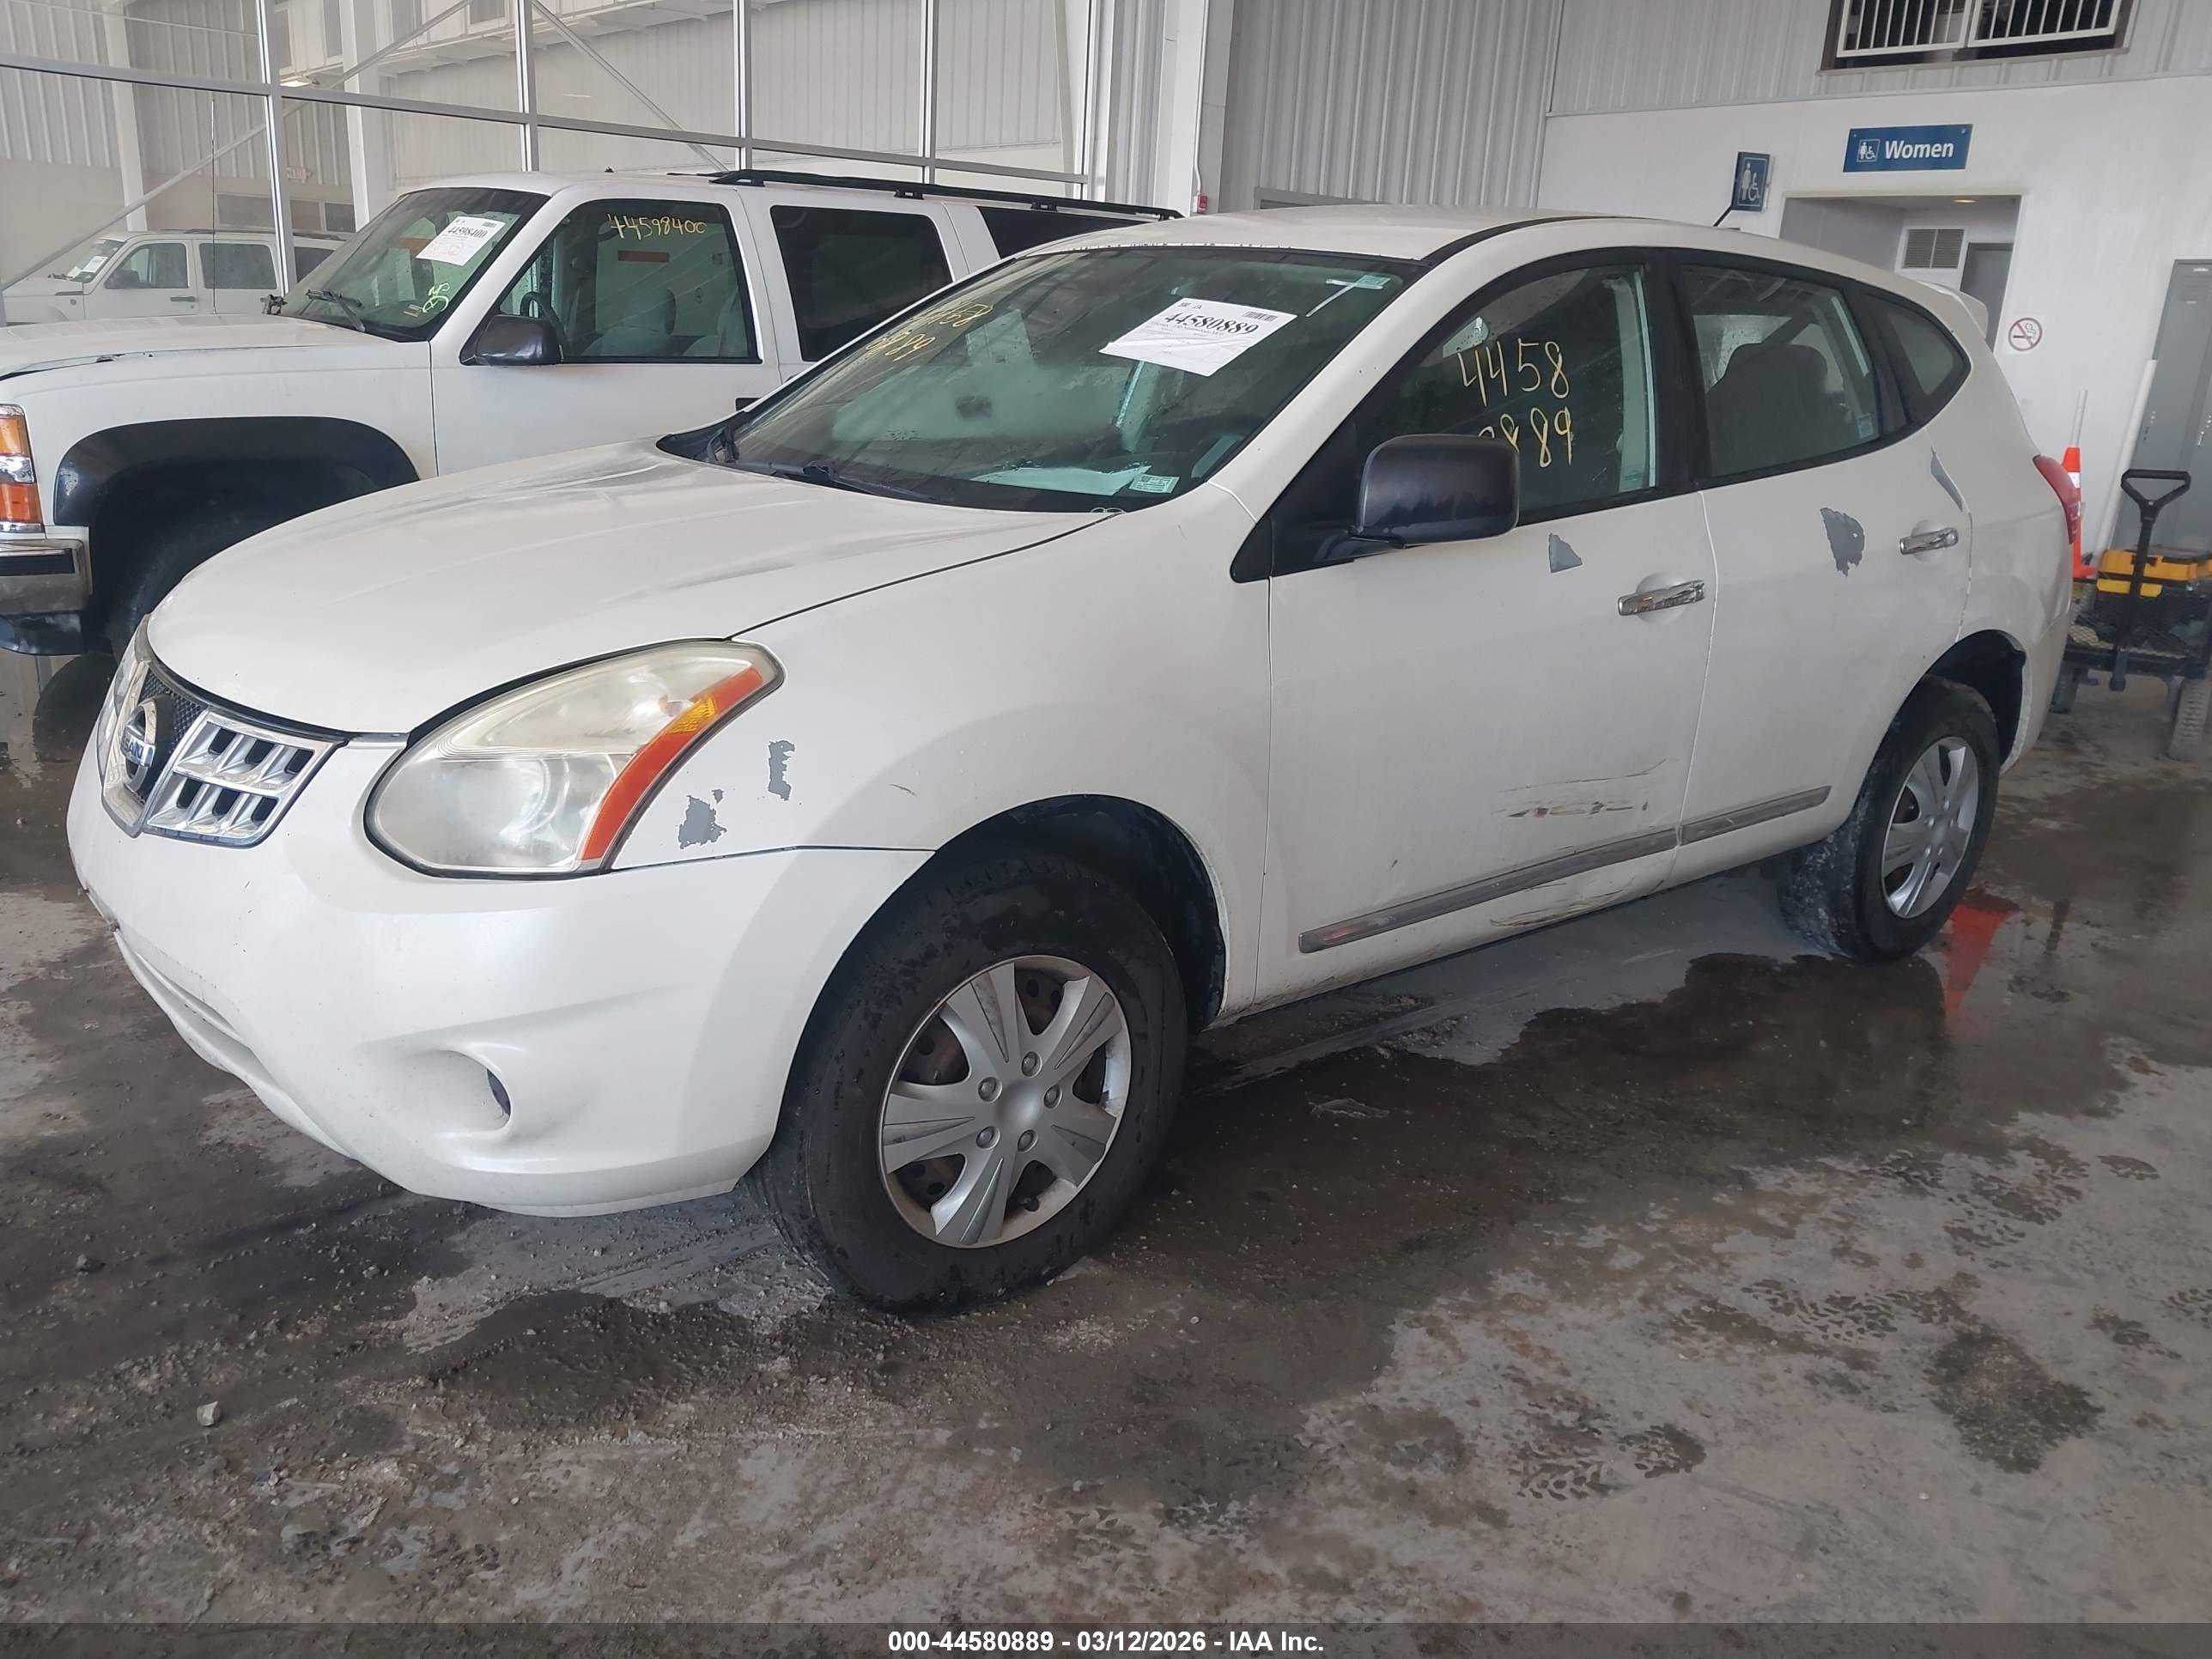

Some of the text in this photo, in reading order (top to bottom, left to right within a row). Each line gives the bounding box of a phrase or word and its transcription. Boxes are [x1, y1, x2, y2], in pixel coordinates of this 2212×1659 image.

[1885, 140, 1954, 160] Women
[1164, 312, 1260, 335] 44580889
[1457, 337, 1570, 407] 4458
[1478, 406, 1572, 467] 889
